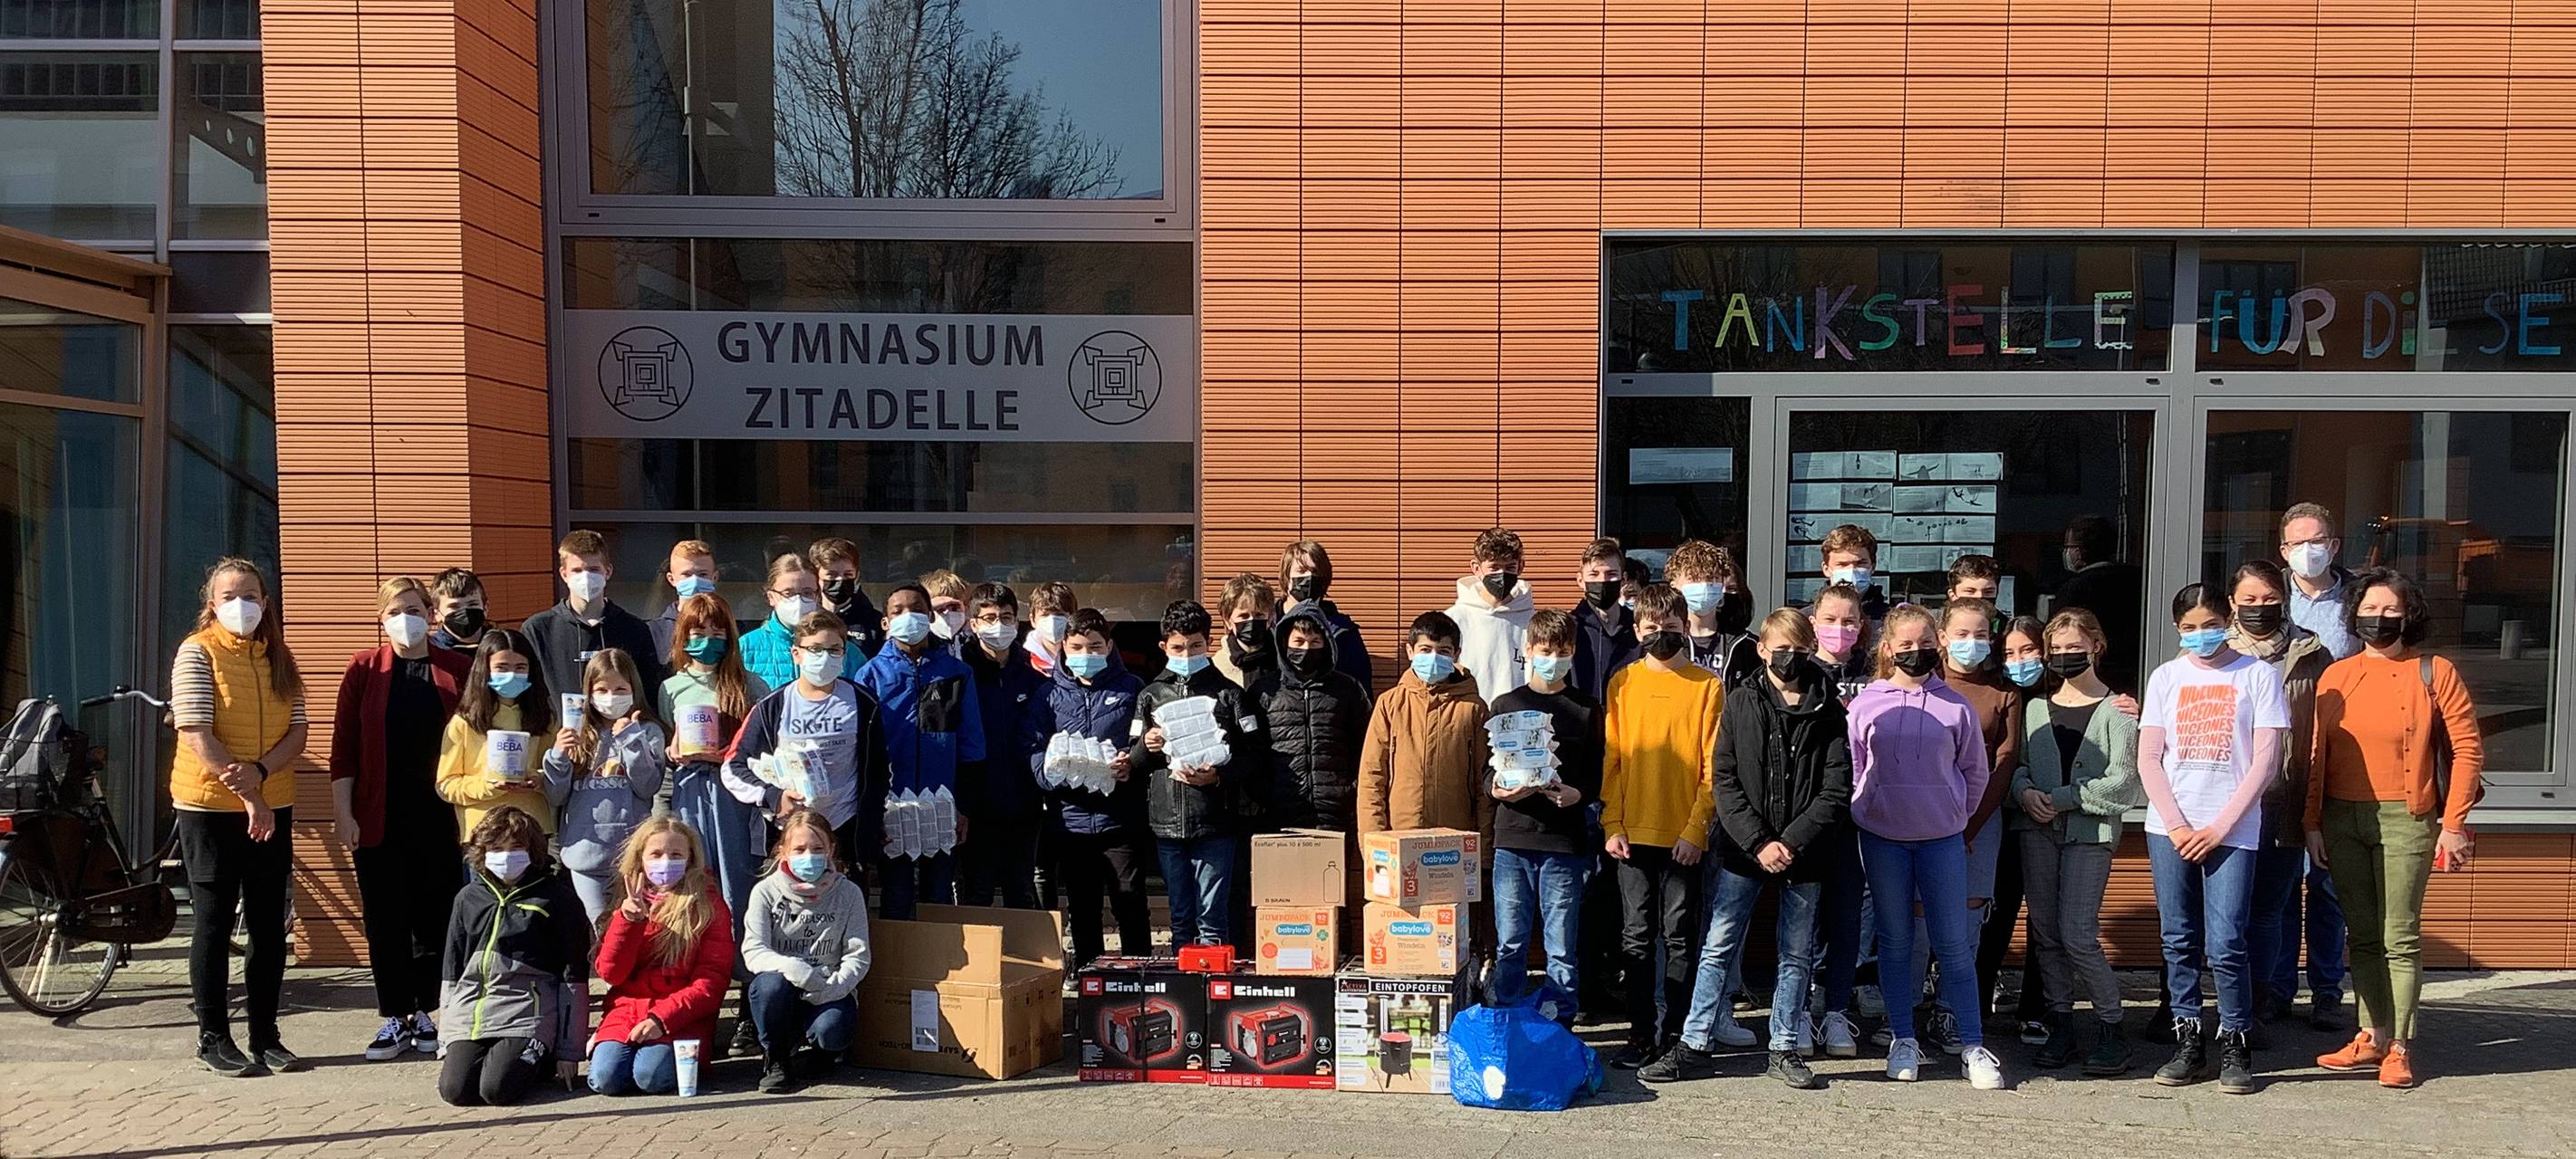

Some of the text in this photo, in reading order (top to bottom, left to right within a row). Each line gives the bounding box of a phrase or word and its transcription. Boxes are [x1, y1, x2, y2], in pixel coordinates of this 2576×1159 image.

[1661, 284, 2133, 360] TANKSTELLE
[2211, 288, 2336, 357] FÜR
[717, 321, 1044, 366] GYMNASIUM
[745, 387, 1020, 431] ZITADELLE
[687, 714, 713, 723] BEBA
[2176, 702, 2236, 723] NICEONES
[2176, 717, 2235, 735] NICEONES
[2177, 732, 2233, 749] NICEONES
[496, 742, 523, 752] BEBA
[1465, 838, 1475, 848] 92
[1422, 854, 1459, 865] babylove
[1408, 880, 1417, 893] 3
[1317, 914, 1327, 922] 92
[803, 925, 816, 937] to
[1277, 924, 1312, 934] babylove
[1391, 924, 1431, 934] babylove
[1374, 948, 1384, 960] 3
[1105, 981, 1167, 992] Einhell
[1234, 985, 1295, 997] Einhell
[1375, 982, 1446, 993] EINTOPFOFEN
